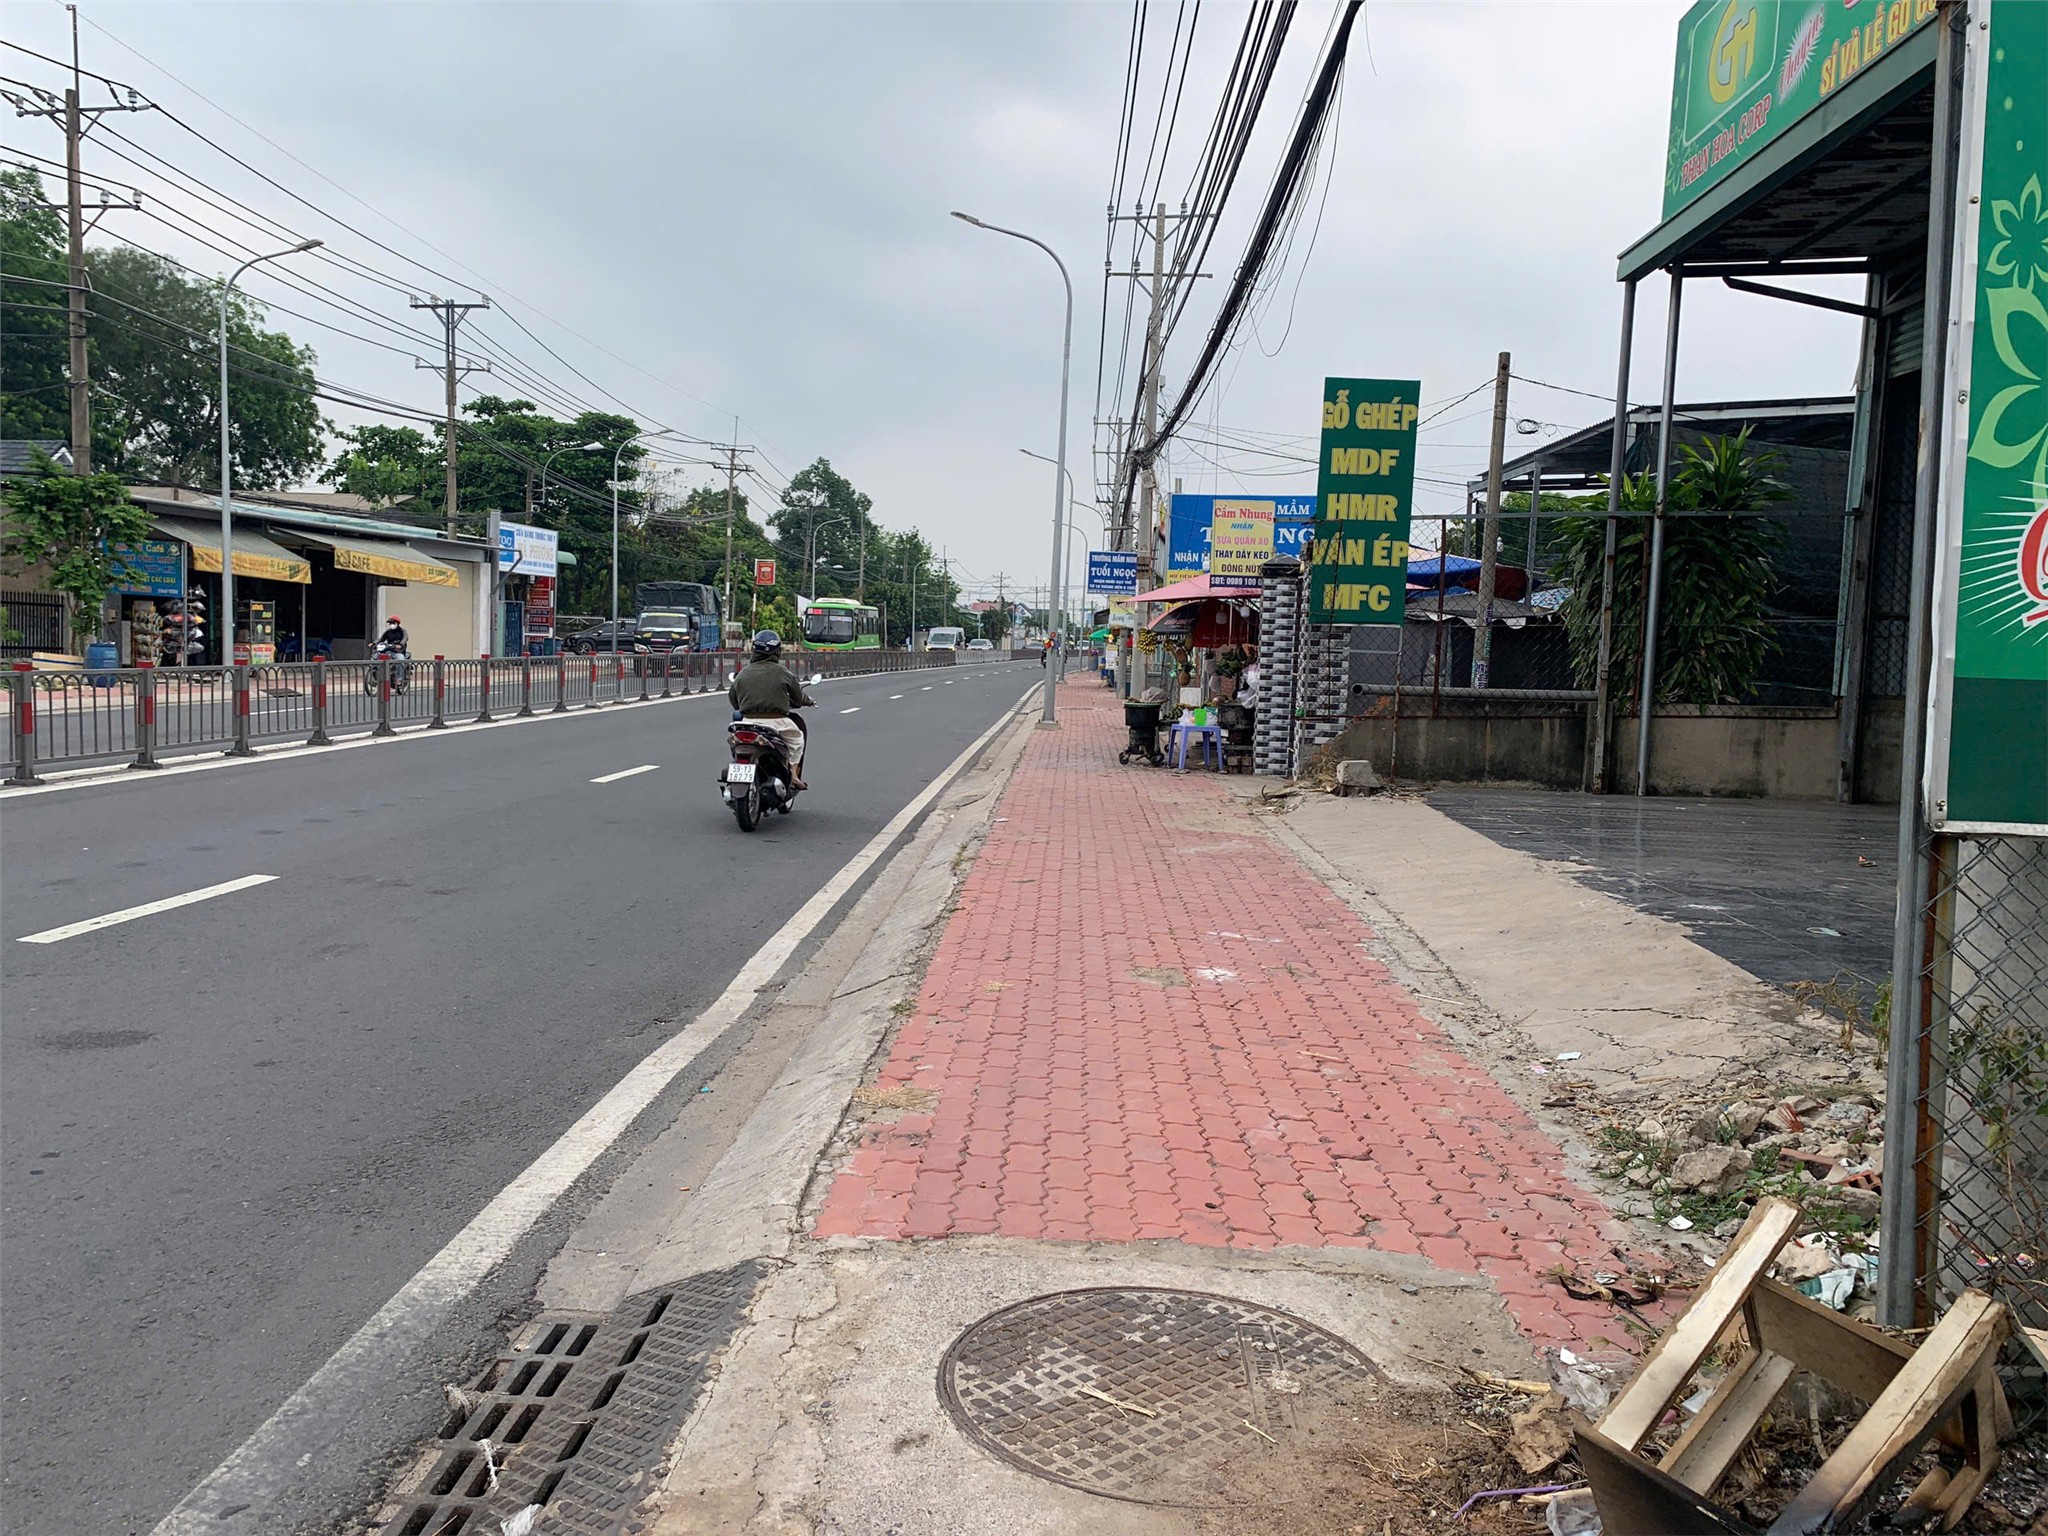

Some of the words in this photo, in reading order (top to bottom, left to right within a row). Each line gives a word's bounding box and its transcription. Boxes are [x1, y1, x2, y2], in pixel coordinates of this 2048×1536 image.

[1840, 27, 1860, 84] VÀ
[1862, 2, 1885, 66] LẺ
[1680, 146, 1711, 190] PHAN
[1710, 123, 1736, 167] HOA
[1738, 93, 1773, 145] CORP
[1322, 389, 1350, 429] GỖ
[1355, 396, 1419, 431] GHÉP
[1330, 447, 1400, 476] MDF
[1239, 507, 1273, 522] Nhung
[1276, 499, 1311, 515] MẦM
[1326, 493, 1398, 521] HMR
[1277, 528, 1316, 544] NG
[1312, 531, 1366, 566] VÁN
[1372, 533, 1409, 567] ÉP
[1174, 549, 1199, 564] NHẬN
[1215, 549, 1234, 559] THAY
[1091, 563, 1111, 577] TUỔI
[1113, 568, 1136, 580] NGỌC
[1322, 583, 1391, 612] MFC
